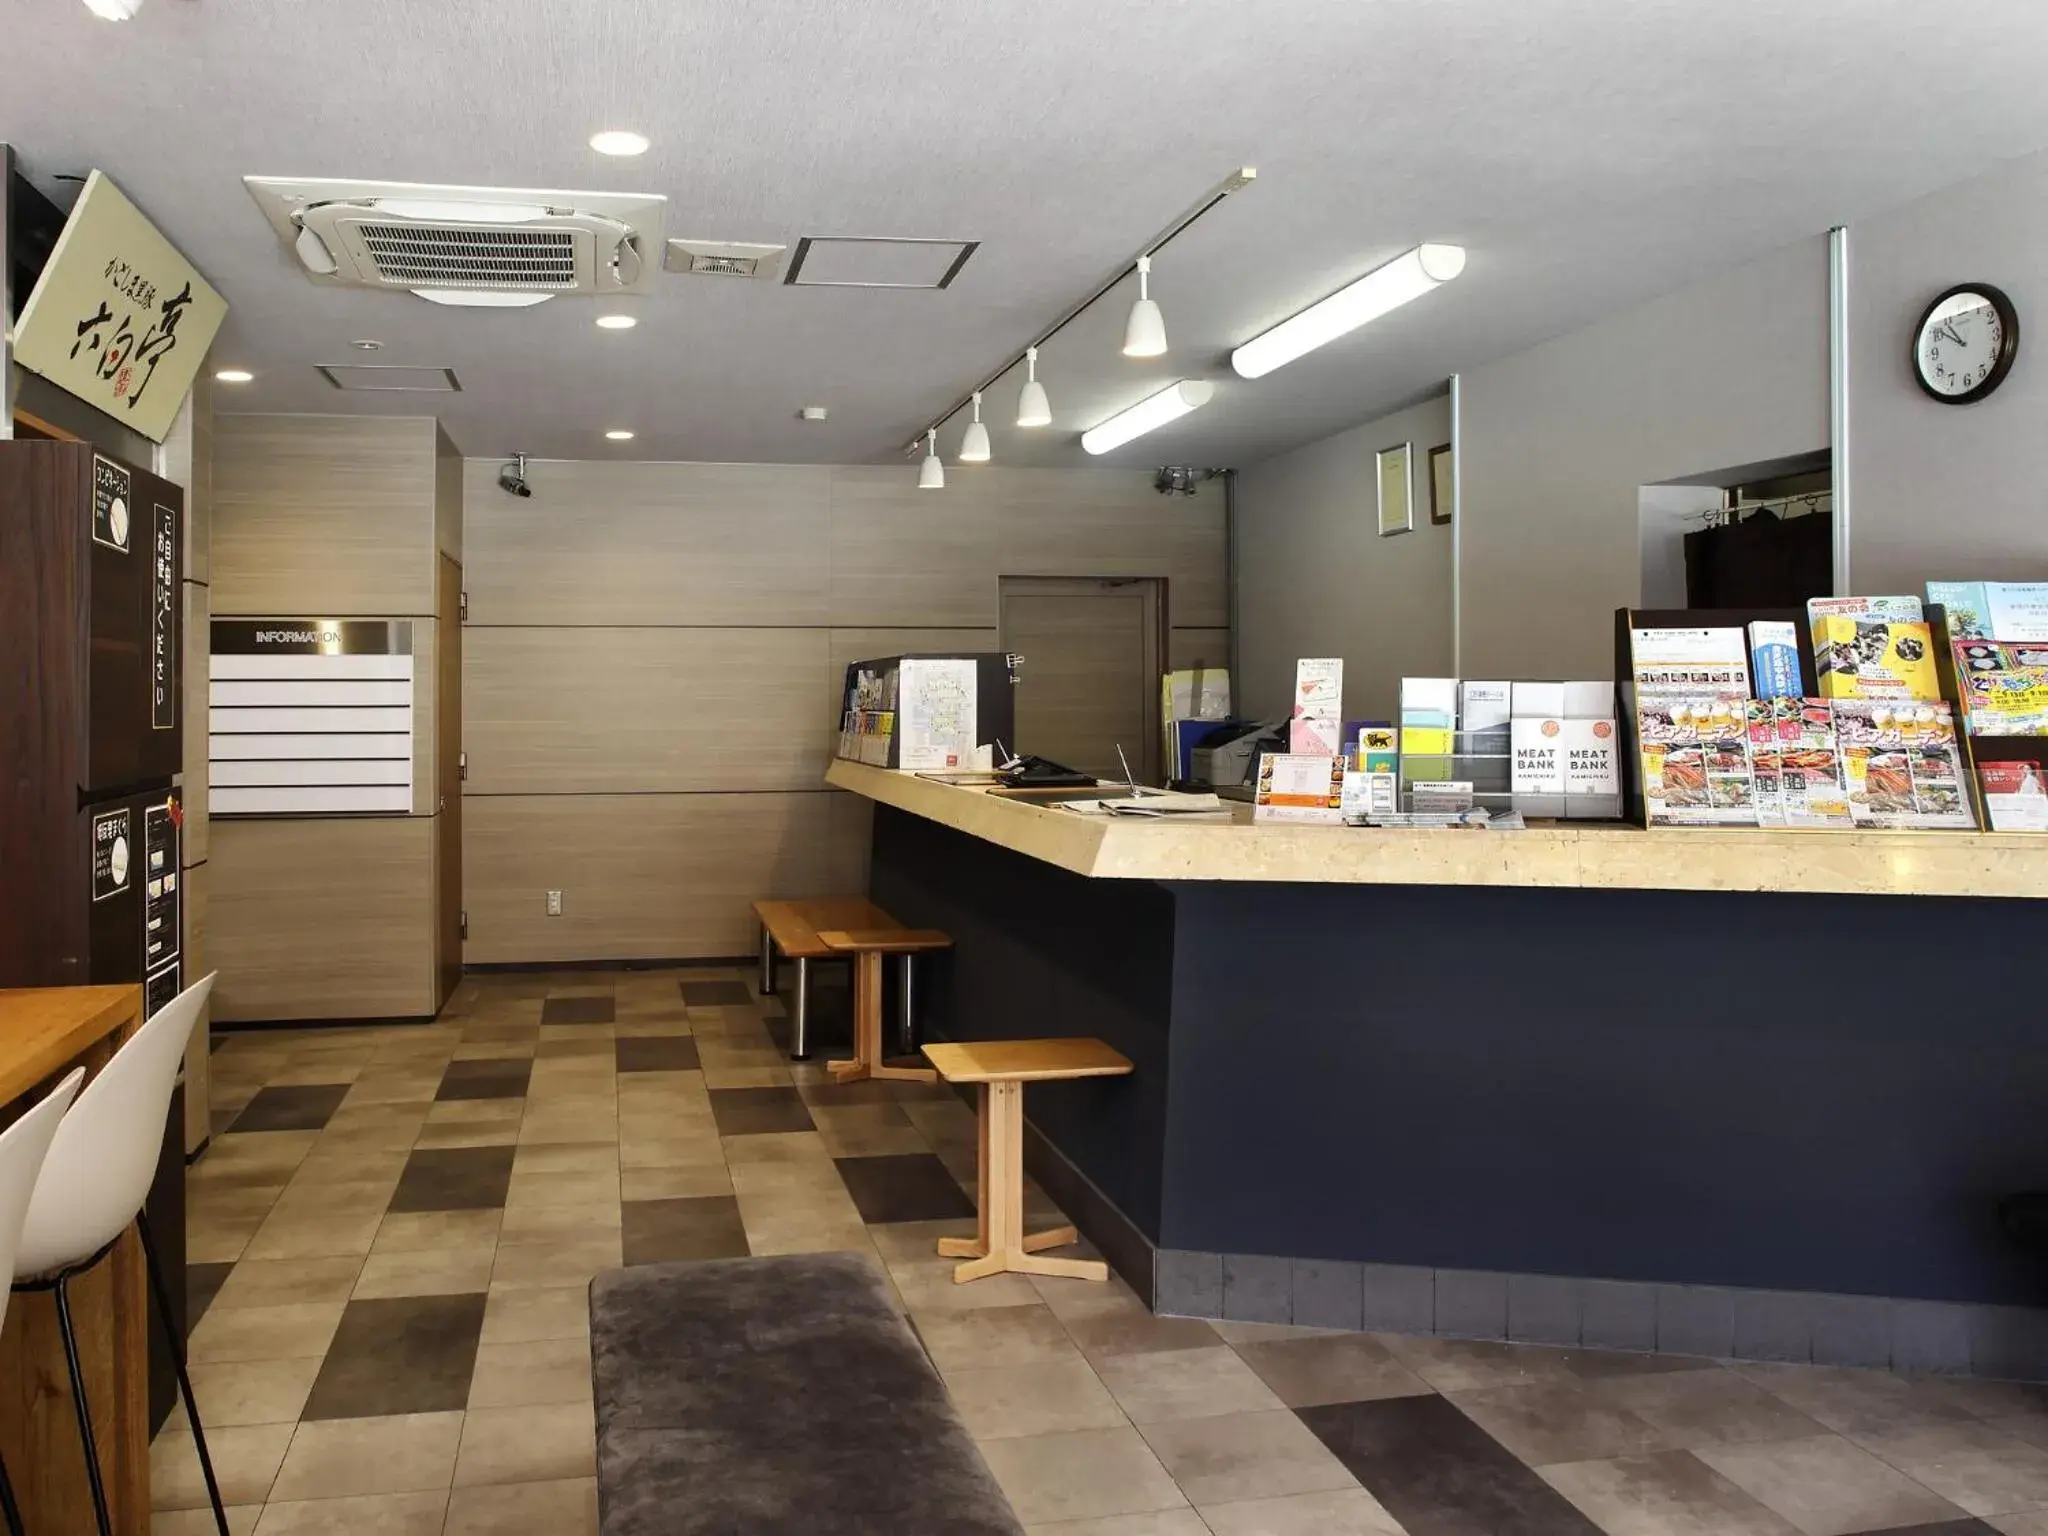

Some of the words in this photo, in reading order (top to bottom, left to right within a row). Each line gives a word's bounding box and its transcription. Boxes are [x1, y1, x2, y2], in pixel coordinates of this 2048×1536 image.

[1986, 311, 1996, 325] 2
[1992, 328, 2000, 342] 3
[1931, 347, 1939, 361] 9
[1989, 347, 1999, 360] 4
[1936, 363, 1945, 378] 8
[1978, 364, 1987, 378] 5
[1948, 372, 1956, 387] 7
[1963, 373, 1971, 386] 6
[256, 631, 342, 643] INFORMATION
[1518, 749, 1555, 758] MEAT
[1570, 750, 1608, 759] MEAT
[1518, 760, 1555, 770] BANK
[1570, 761, 1608, 770] BANK
